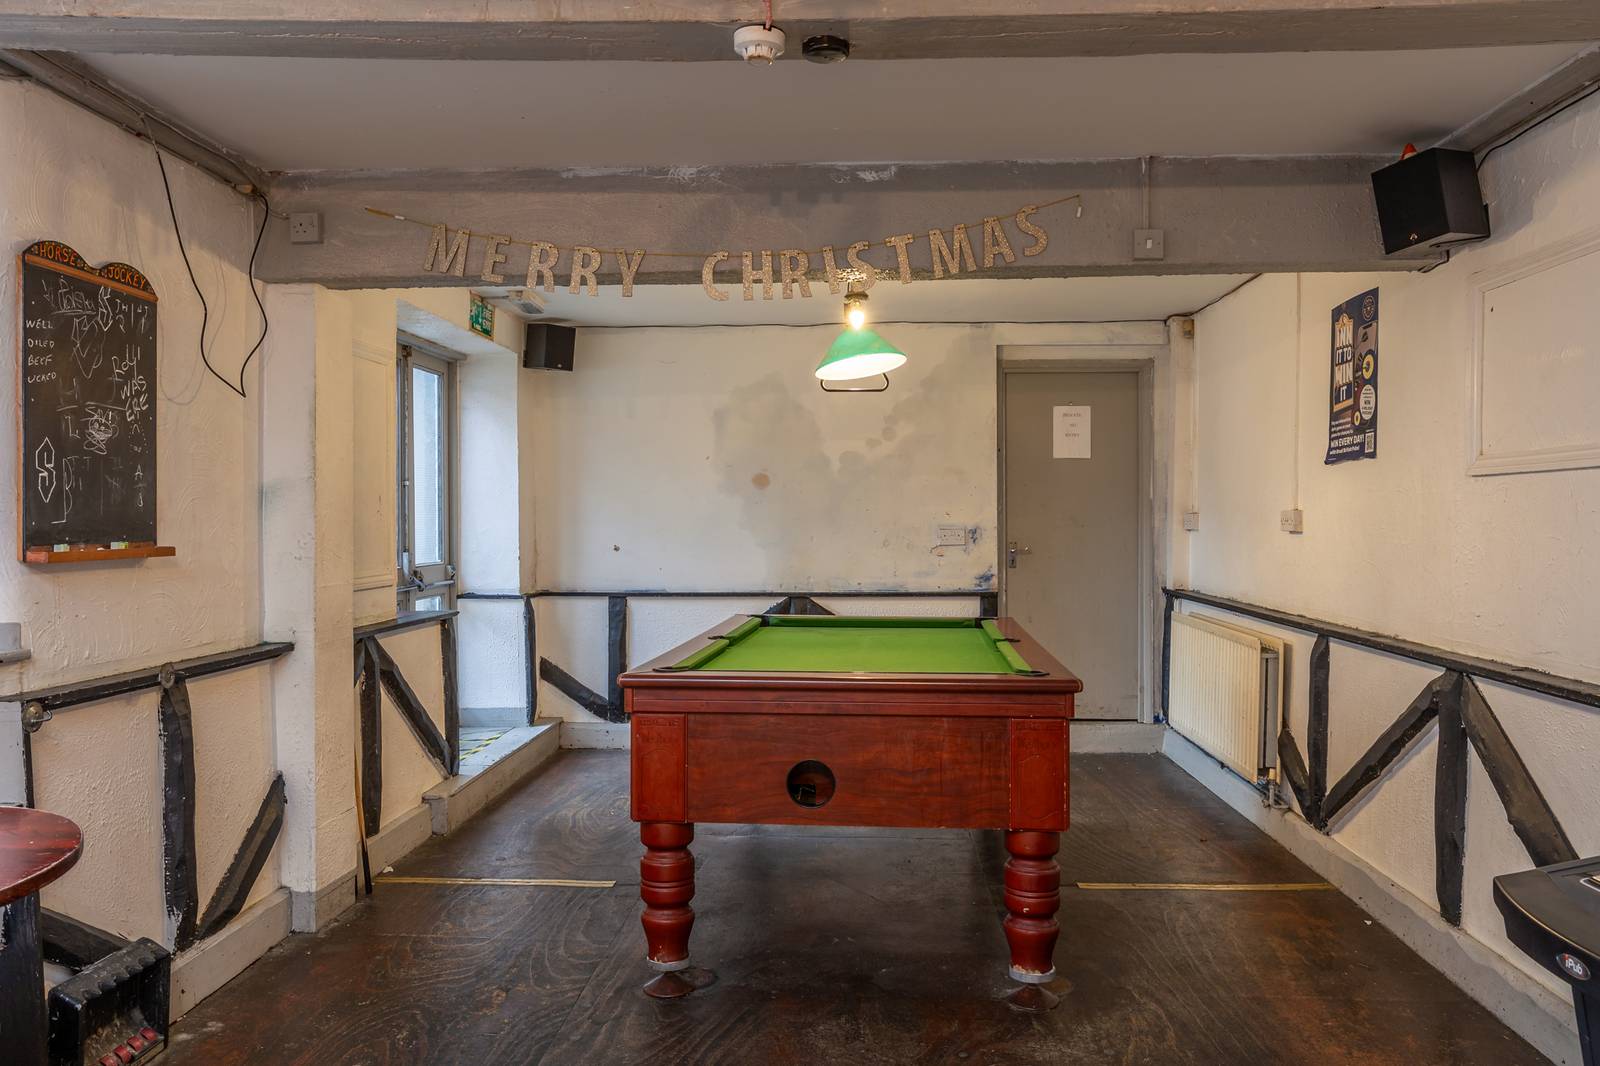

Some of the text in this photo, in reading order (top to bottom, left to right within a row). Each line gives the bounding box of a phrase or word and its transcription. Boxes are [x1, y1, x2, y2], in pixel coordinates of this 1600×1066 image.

[423, 205, 1049, 301] MERRY CHRISTMAS
[40, 243, 146, 289] HORSE JOCKEY
[26, 318, 53, 329] WELL
[1336, 346, 1352, 364] IT TO
[1336, 362, 1352, 387] WIN
[120, 375, 147, 400] WAS
[1340, 385, 1347, 401] IT
[1339, 436, 1353, 446] EVERY
